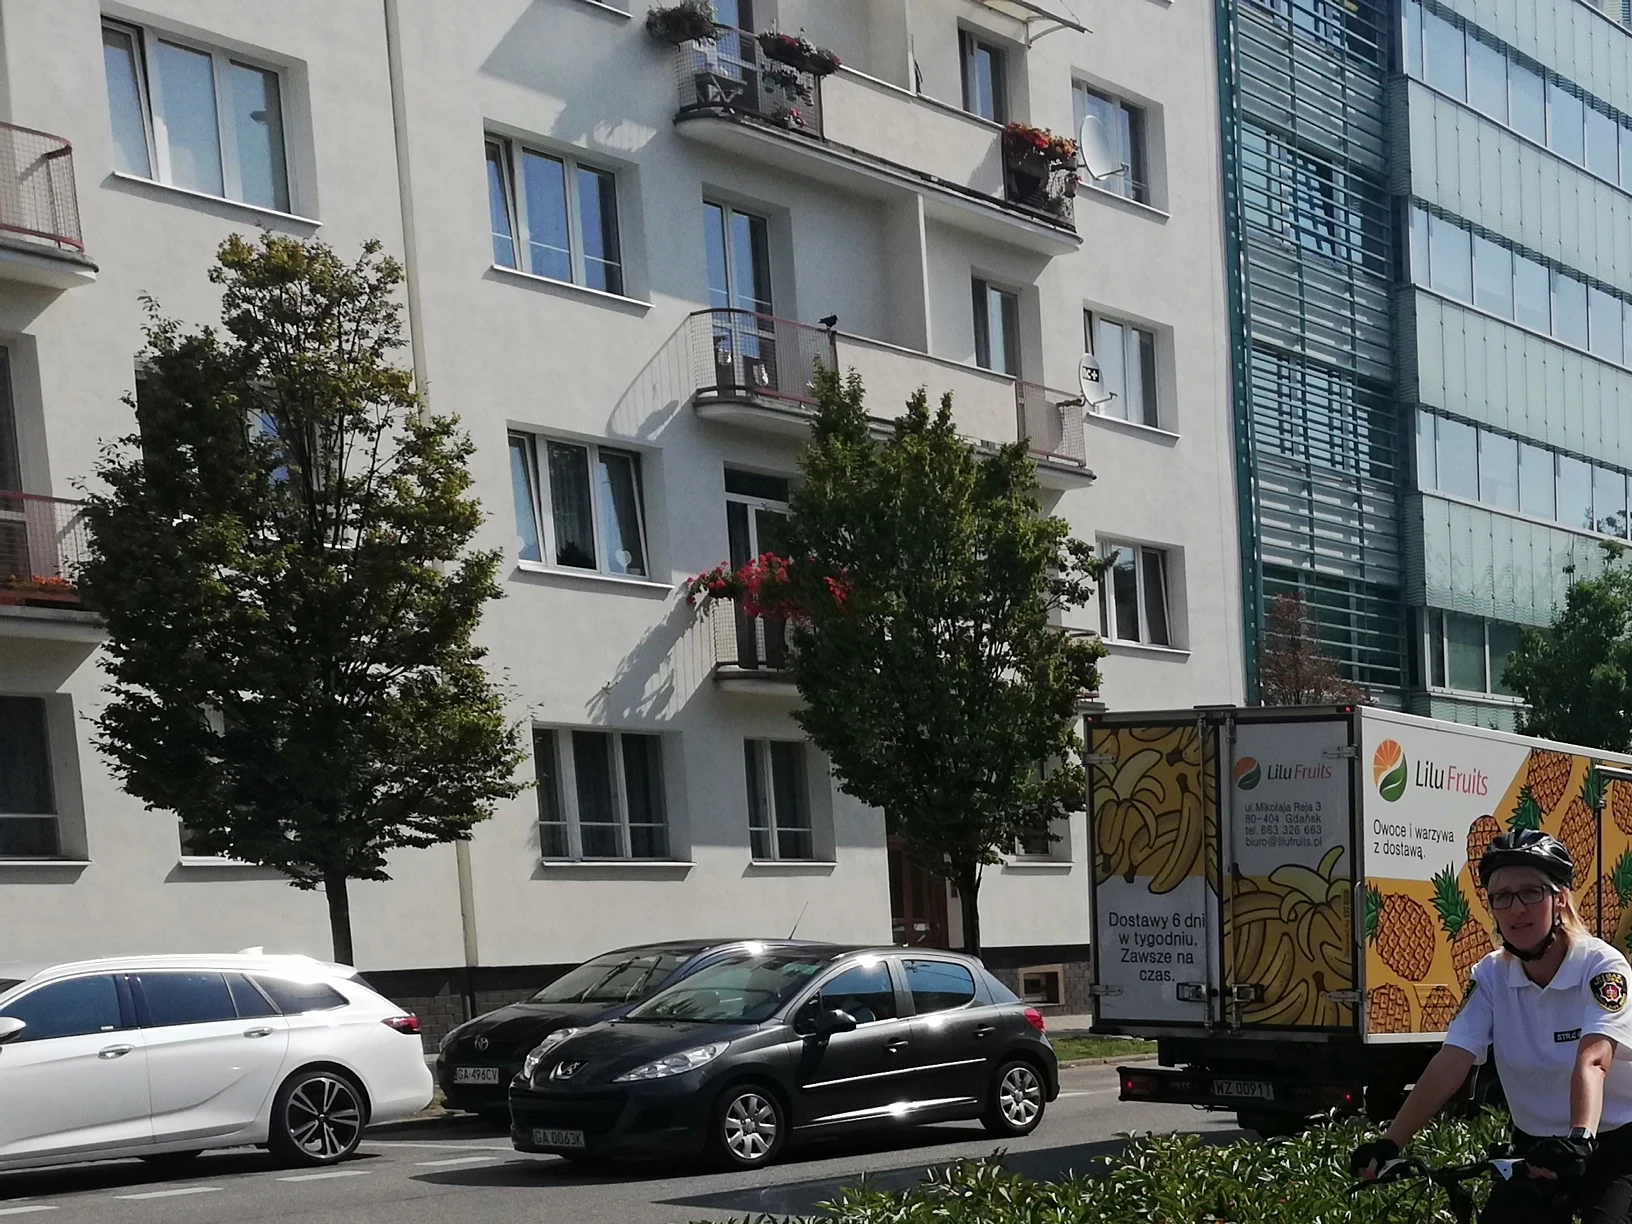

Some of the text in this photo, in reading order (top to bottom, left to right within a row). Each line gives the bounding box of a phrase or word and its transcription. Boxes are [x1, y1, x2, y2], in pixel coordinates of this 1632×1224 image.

[1267, 763, 1332, 780] Lilu Fruits
[1415, 760, 1488, 796] Lilu Fruits
[1294, 802, 1313, 813] Reja
[1315, 801, 1321, 812] 3
[1245, 813, 1322, 824] 80-404 Gdańsk
[1261, 825, 1279, 835] 663
[1283, 825, 1300, 835] 326
[1304, 825, 1322, 835] 663
[1373, 819, 1407, 838] Owoce
[1415, 827, 1455, 844] warzywa
[1374, 840, 1426, 860] z dostawą.
[1109, 912, 1205, 930] Dostawy 6 dni
[1118, 931, 1198, 948] w tygodniu.
[1120, 948, 1194, 964] Zawsze na
[1139, 969, 1175, 982] czas.
[458, 1068, 498, 1080] GA 496CV
[1216, 1081, 1271, 1097] WZ 0091T
[534, 1130, 550, 1144] GA
